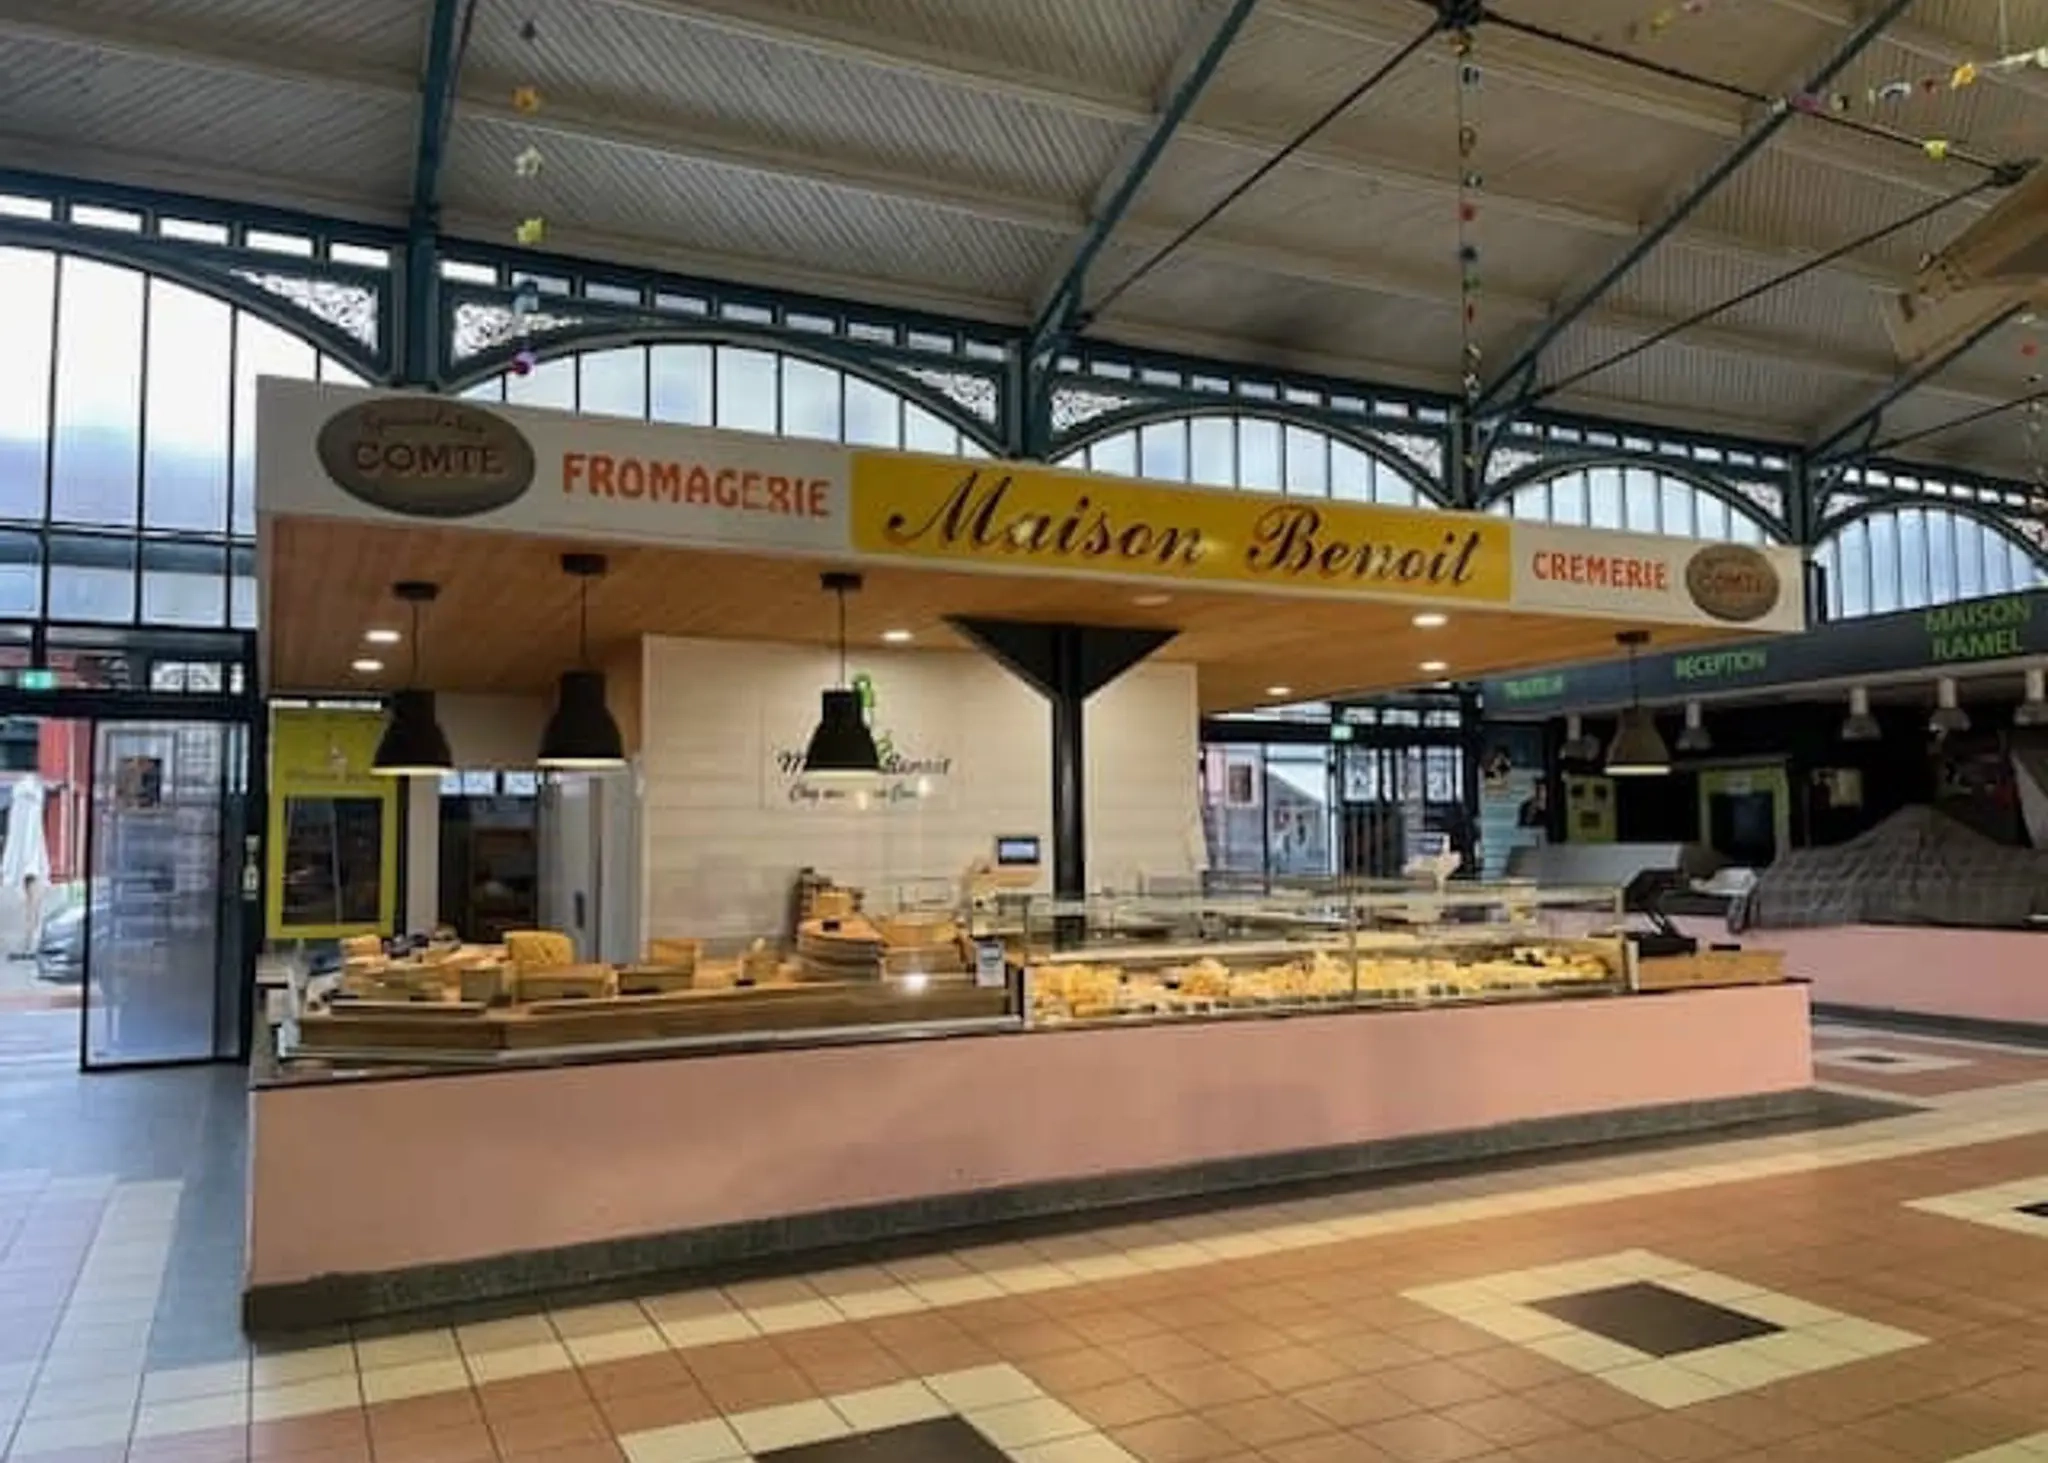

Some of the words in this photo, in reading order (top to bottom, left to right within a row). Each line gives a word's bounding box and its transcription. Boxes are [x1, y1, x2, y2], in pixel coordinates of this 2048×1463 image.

[562, 452, 832, 518] FROMAGERIE
[883, 469, 1208, 565] Maison
[1246, 503, 1482, 588] Benoit
[1532, 551, 1669, 591] CREMERIE
[1926, 598, 2032, 632] MAISON
[1932, 628, 2022, 661] RAMEL
